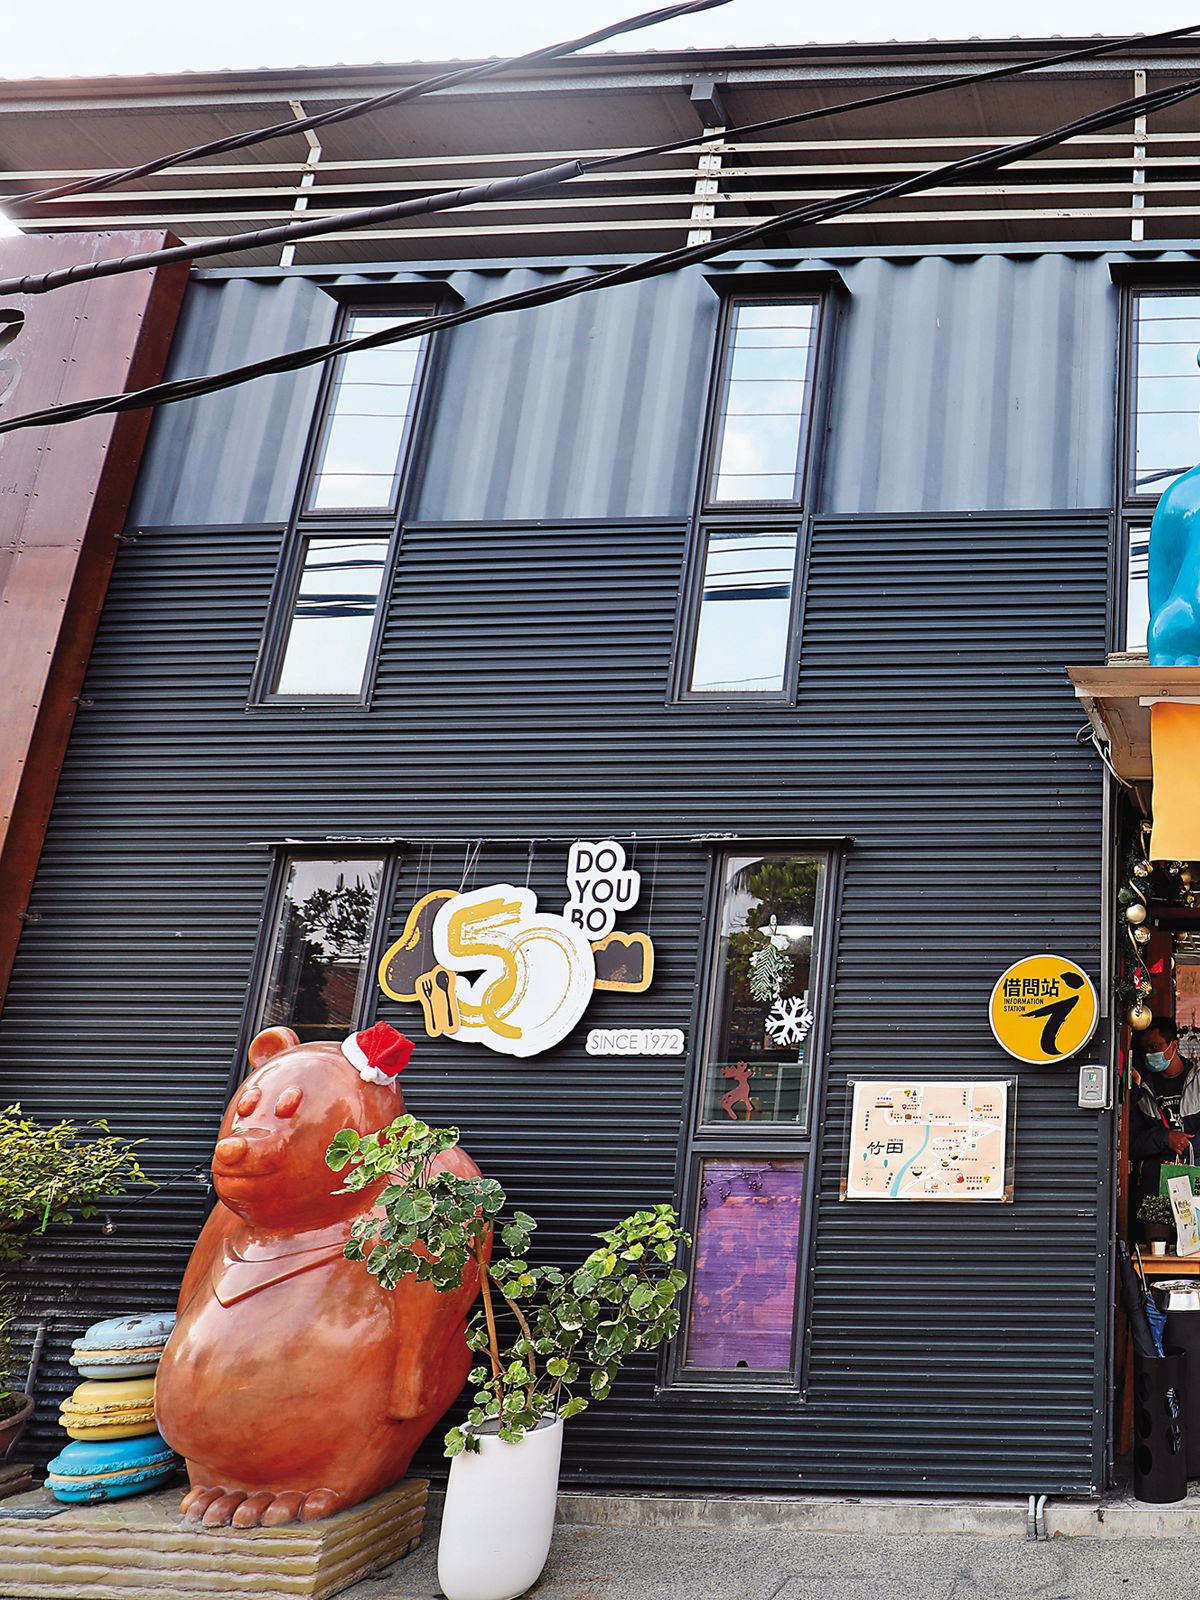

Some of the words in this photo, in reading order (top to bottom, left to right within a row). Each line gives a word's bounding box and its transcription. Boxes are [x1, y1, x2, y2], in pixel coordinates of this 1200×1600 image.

[575, 848, 618, 873] DO
[575, 878, 633, 904] YOU
[571, 907, 608, 932] BO
[1003, 977, 1060, 998] 借問站
[1003, 997, 1044, 1005] INFORMATION
[591, 1036, 639, 1051] SINCE
[643, 1034, 680, 1050] 1972
[867, 1141, 904, 1156] 竹田
